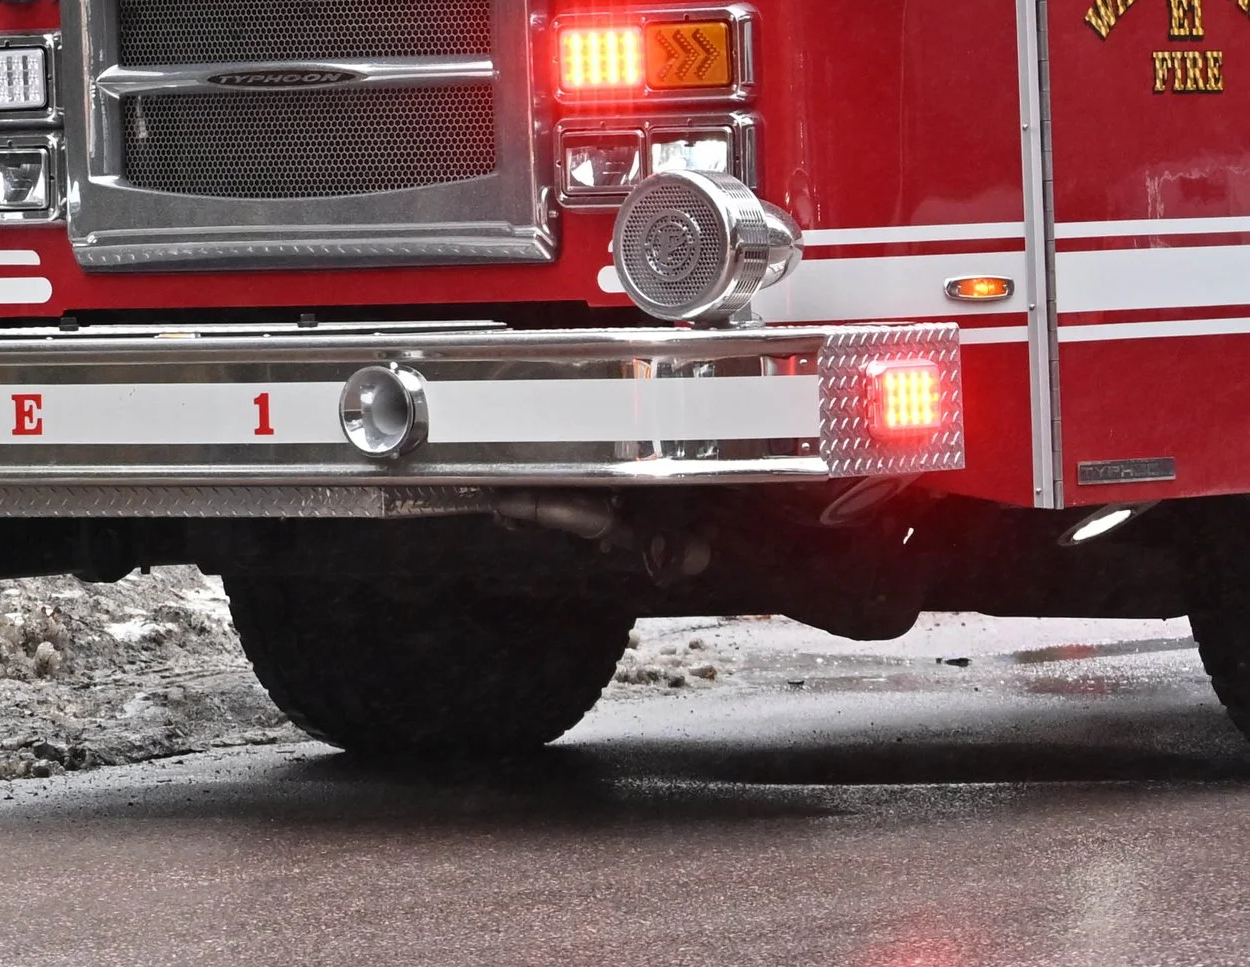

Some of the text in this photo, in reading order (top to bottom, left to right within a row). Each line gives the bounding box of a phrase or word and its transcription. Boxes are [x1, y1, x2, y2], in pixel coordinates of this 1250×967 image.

[219, 72, 343, 84] TYPHOON
[1152, 50, 1224, 94] FIRE
[11, 392, 275, 436] E 1
